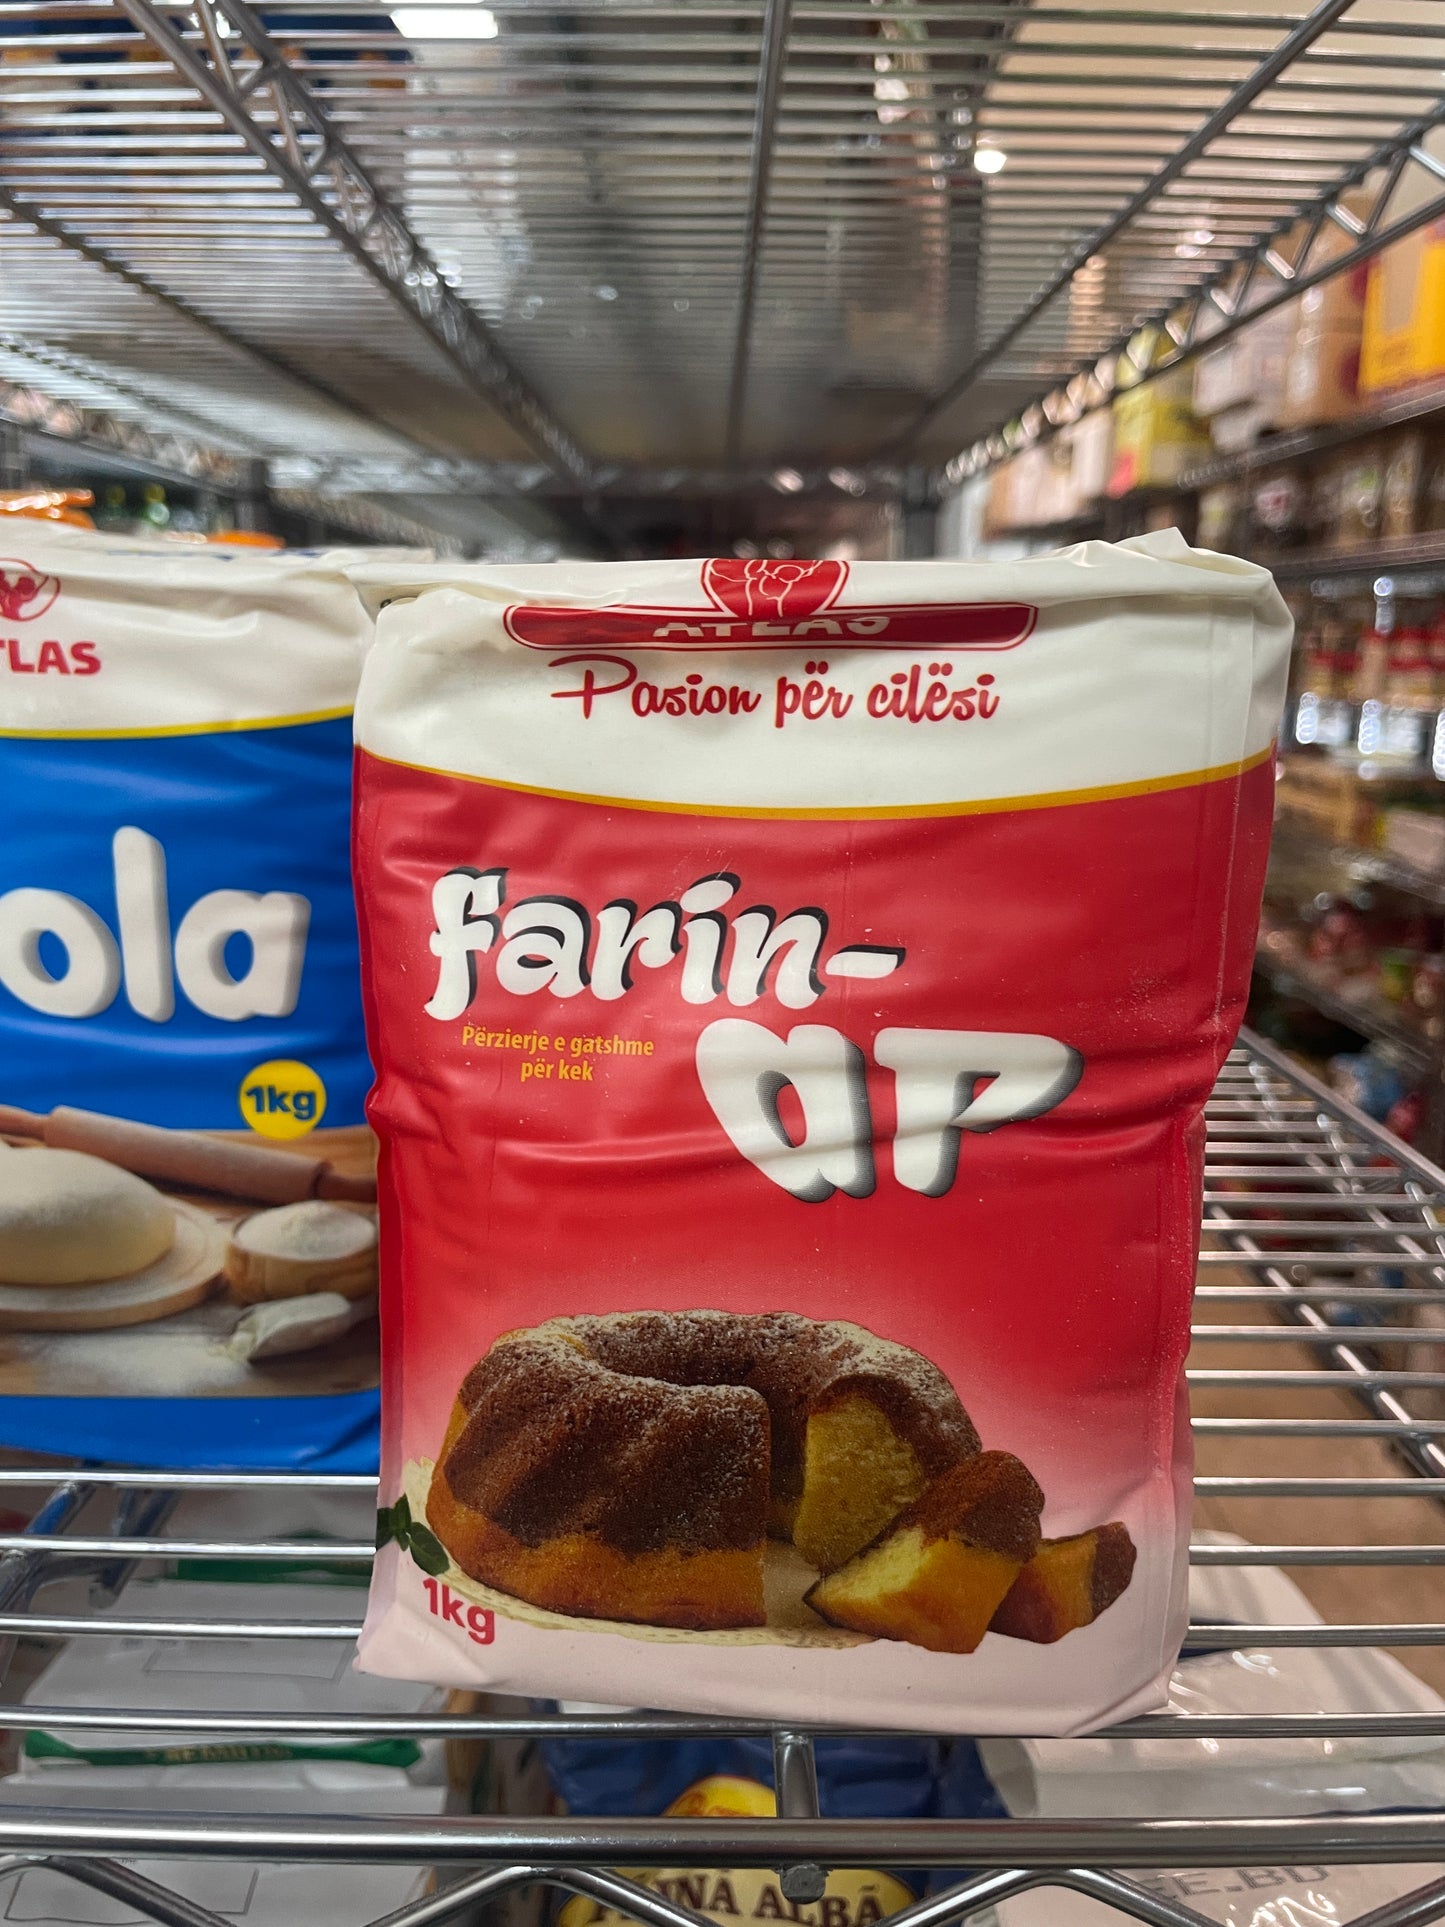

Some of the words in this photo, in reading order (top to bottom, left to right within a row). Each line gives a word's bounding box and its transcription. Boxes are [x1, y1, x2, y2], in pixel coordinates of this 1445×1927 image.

[0, 639, 102, 676] LAS
[548, 654, 762, 719] Pasion
[774, 660, 854, 728] për
[866, 662, 1001, 723] cilësi
[424, 866, 906, 1021] farin-
[461, 1025, 549, 1055] Përzierje
[554, 1036, 566, 1051] e
[570, 1034, 654, 1058] gatshme
[520, 1058, 555, 1082] për
[558, 1059, 593, 1081] kek
[246, 1085, 317, 1121] 1kg
[423, 1577, 495, 1645] 1kg
